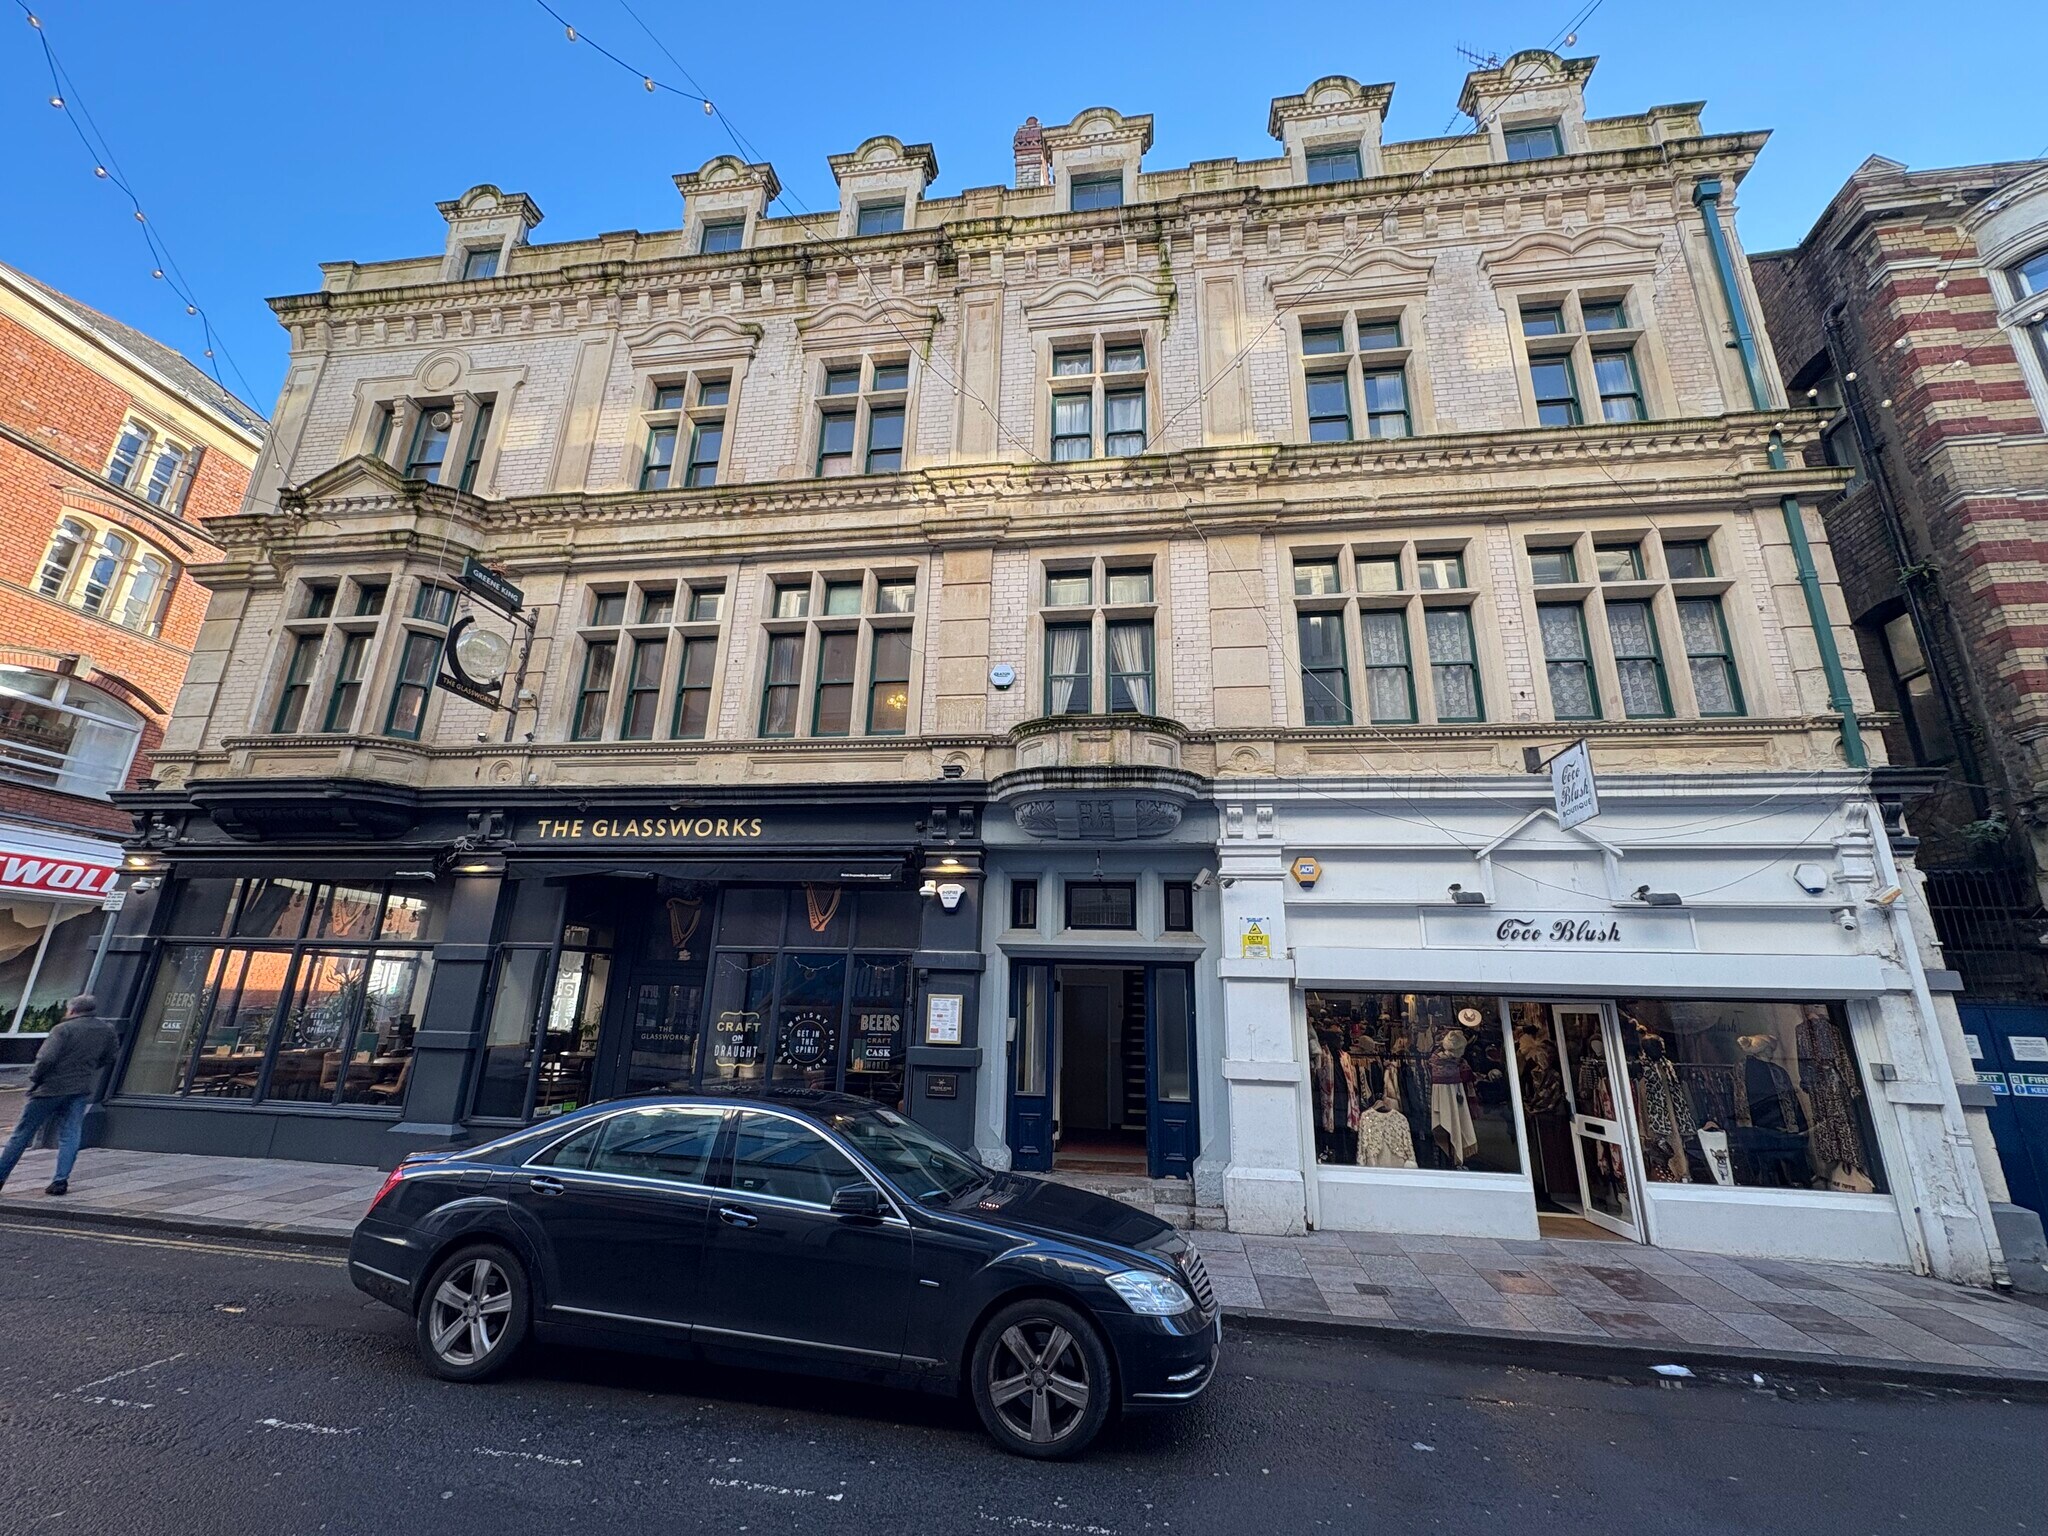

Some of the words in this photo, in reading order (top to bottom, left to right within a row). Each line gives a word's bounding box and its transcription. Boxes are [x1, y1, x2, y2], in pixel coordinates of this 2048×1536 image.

[473, 569, 500, 591] GREENE
[500, 587, 518, 602] KING
[443, 676, 456, 688] THE
[455, 683, 495, 705] GLASSWORKS
[1561, 760, 1580, 785] Coco
[1560, 778, 1589, 808] Blush
[1562, 798, 1592, 818] BOUTIQUE
[537, 819, 584, 838] THE
[592, 818, 763, 837] GLASSWORKS
[1300, 865, 1315, 874] ADT
[1496, 918, 1541, 941] Coco
[1549, 919, 1621, 941] Blush
[164, 992, 196, 1008] BEERS
[161, 1021, 182, 1030] CASK
[716, 1021, 761, 1033] CRAFT
[787, 1012, 828, 1028] WHISKY
[860, 1014, 900, 1032] BEERS
[659, 1025, 673, 1033] THE
[796, 1029, 809, 1038] GET
[812, 1030, 820, 1038] IN
[640, 1032, 688, 1041] GLASSWORKS
[731, 1034, 744, 1042] ON
[801, 1038, 814, 1046] THE
[713, 1044, 759, 1058] DRAUGHT
[795, 1045, 819, 1054] SPIRIT
[865, 1048, 891, 1057] CASK
